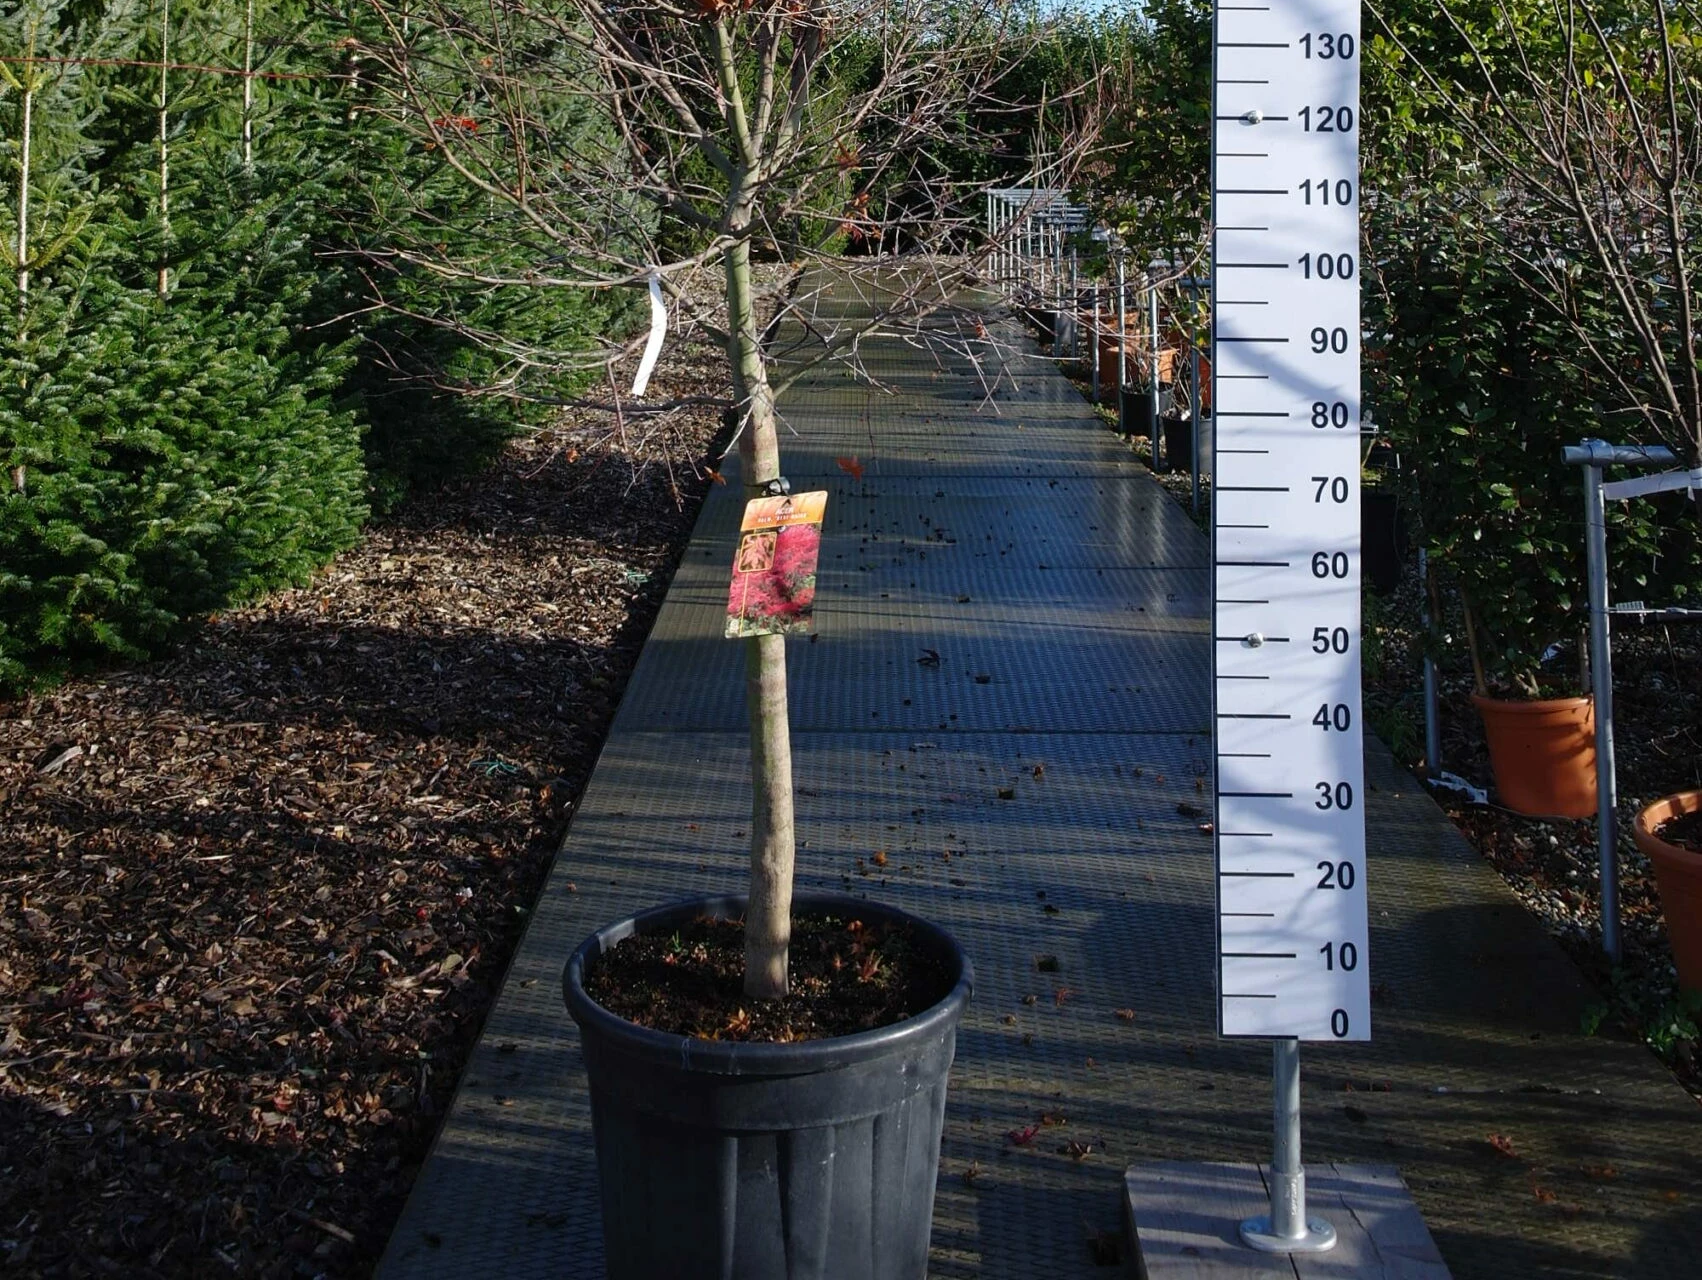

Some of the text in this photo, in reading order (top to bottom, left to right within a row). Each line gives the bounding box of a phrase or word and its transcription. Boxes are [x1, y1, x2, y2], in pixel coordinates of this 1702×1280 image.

[1298, 32, 1355, 60] 130
[1297, 105, 1354, 133] 120
[1298, 178, 1353, 206] 110
[1297, 252, 1354, 280] 100
[1310, 327, 1348, 354] 90
[1310, 401, 1349, 429] 80
[1310, 476, 1349, 504] 70
[1310, 551, 1349, 579] 60
[1311, 626, 1350, 655] 50
[1311, 703, 1352, 733] 40
[1314, 781, 1354, 812] 30
[1315, 860, 1356, 891] 20
[1318, 941, 1358, 973] 10
[1329, 1007, 1350, 1039] 0
